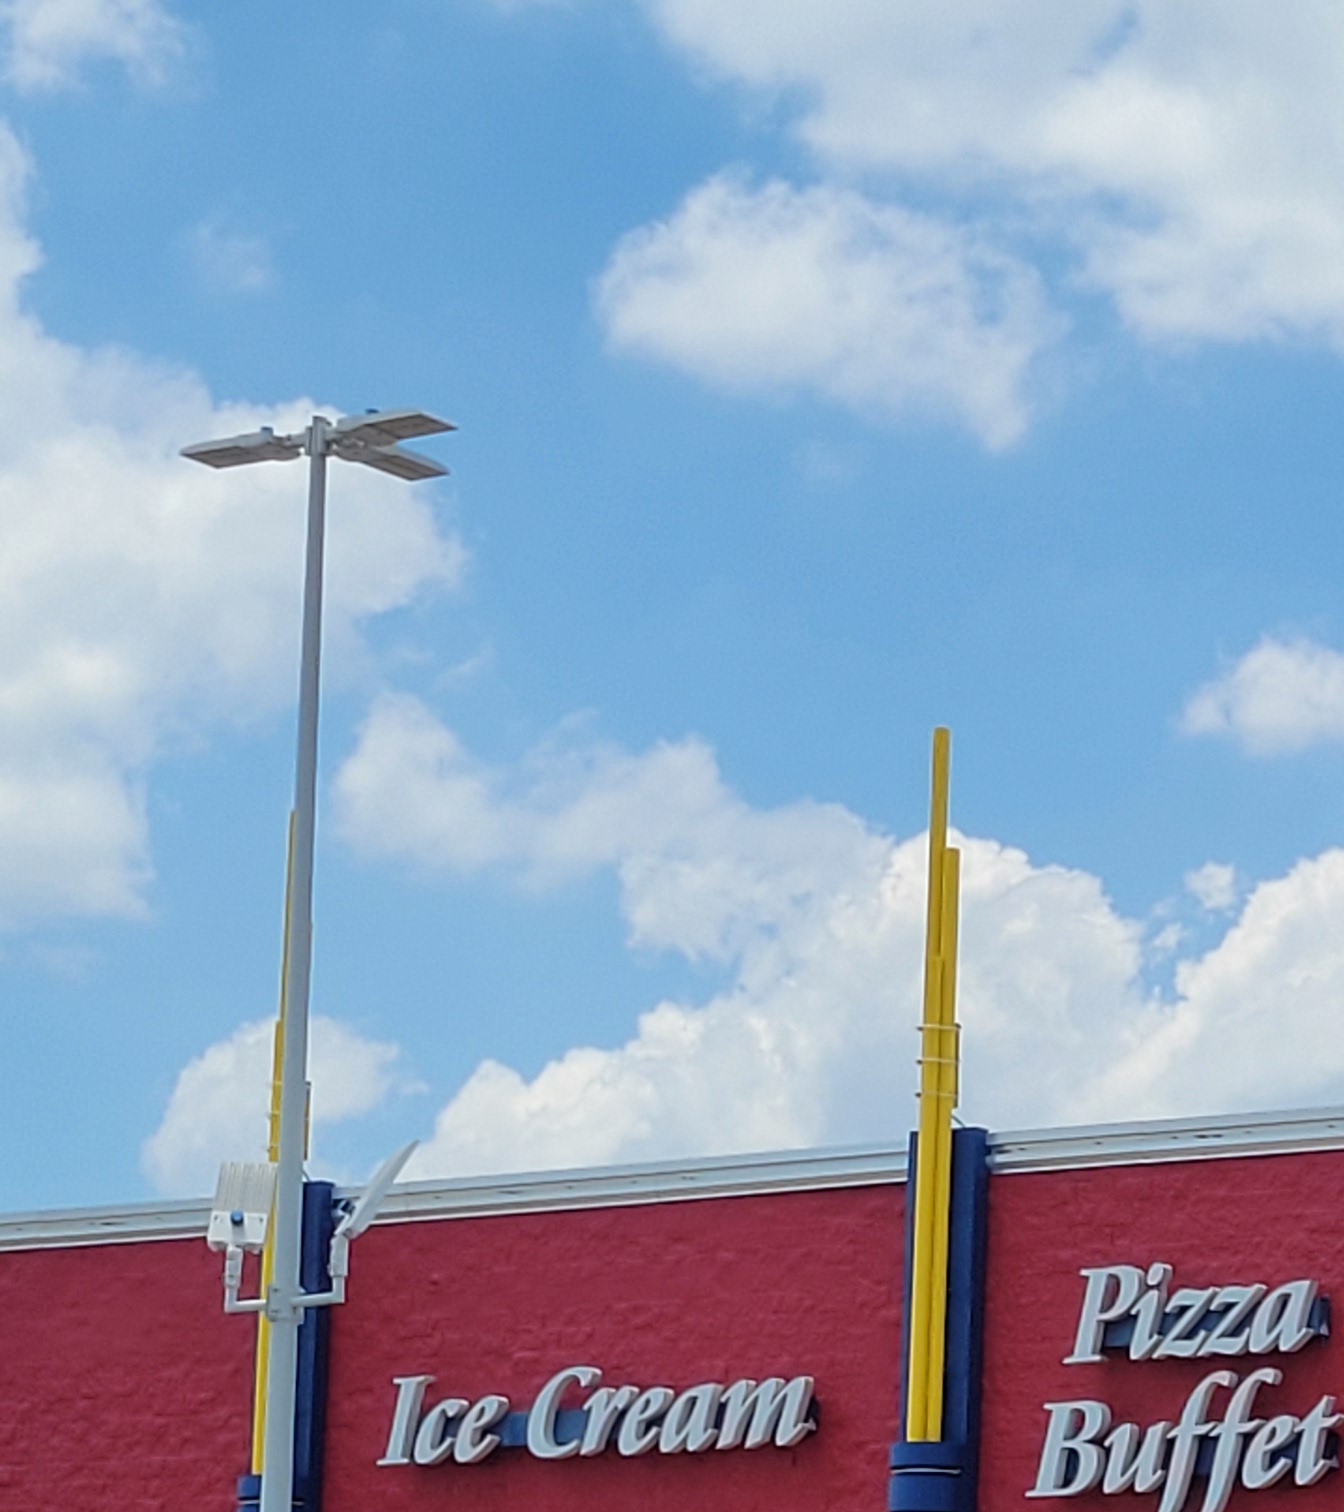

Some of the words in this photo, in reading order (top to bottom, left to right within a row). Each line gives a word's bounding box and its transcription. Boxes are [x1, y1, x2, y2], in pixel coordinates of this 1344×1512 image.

[1062, 1262, 1319, 1365] Pizza
[376, 1374, 510, 1466] Ice
[525, 1364, 818, 1460] Cream
